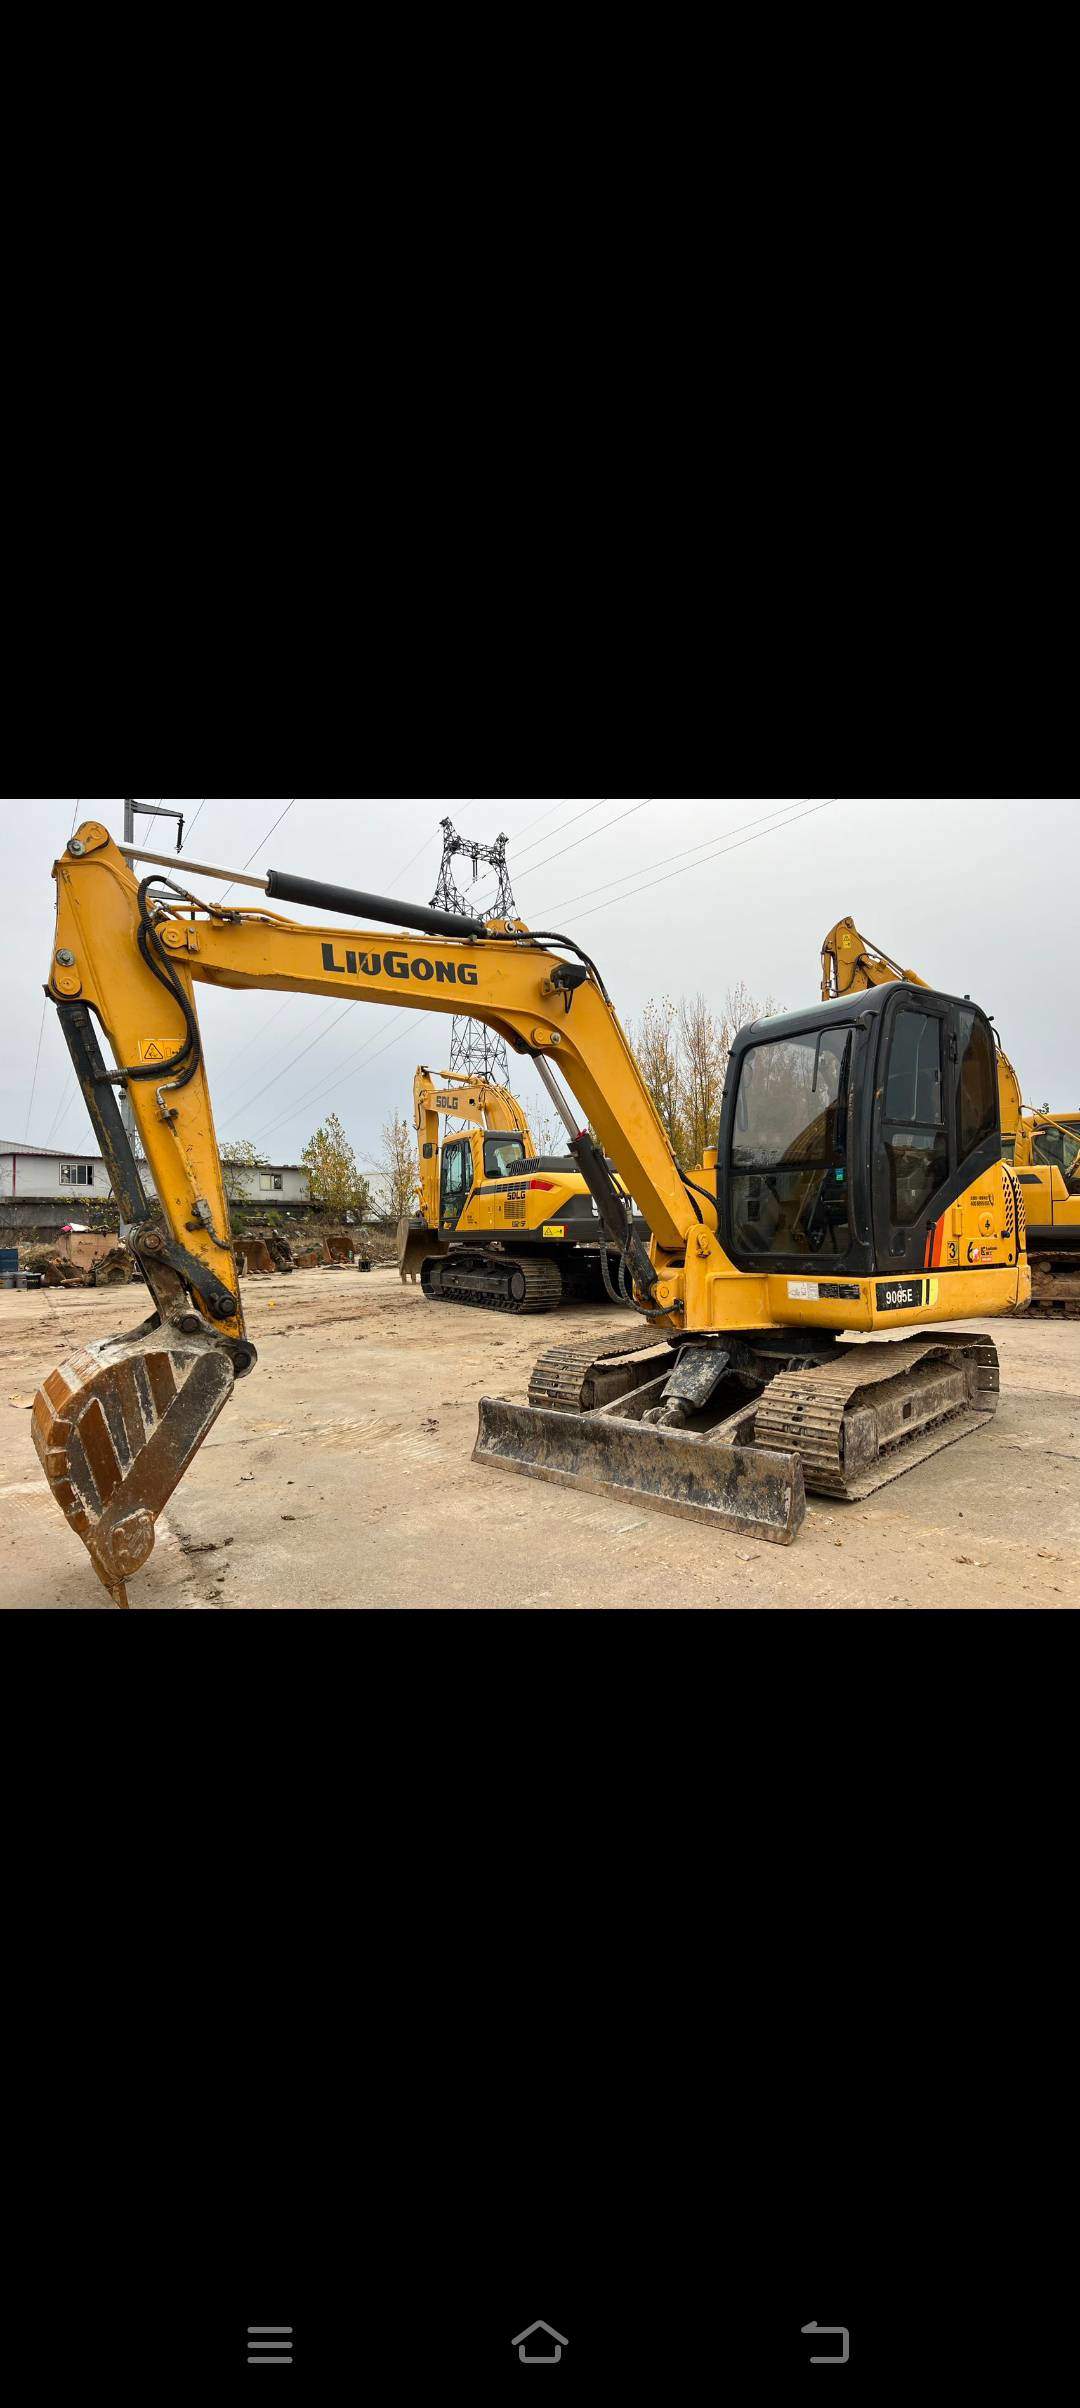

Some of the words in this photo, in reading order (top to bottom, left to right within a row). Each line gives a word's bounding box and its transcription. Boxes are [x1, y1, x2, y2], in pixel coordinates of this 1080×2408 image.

[436, 1096, 458, 1109] SDLG
[506, 1191, 526, 1200] SDLG
[886, 1288, 913, 1304] 9065E
